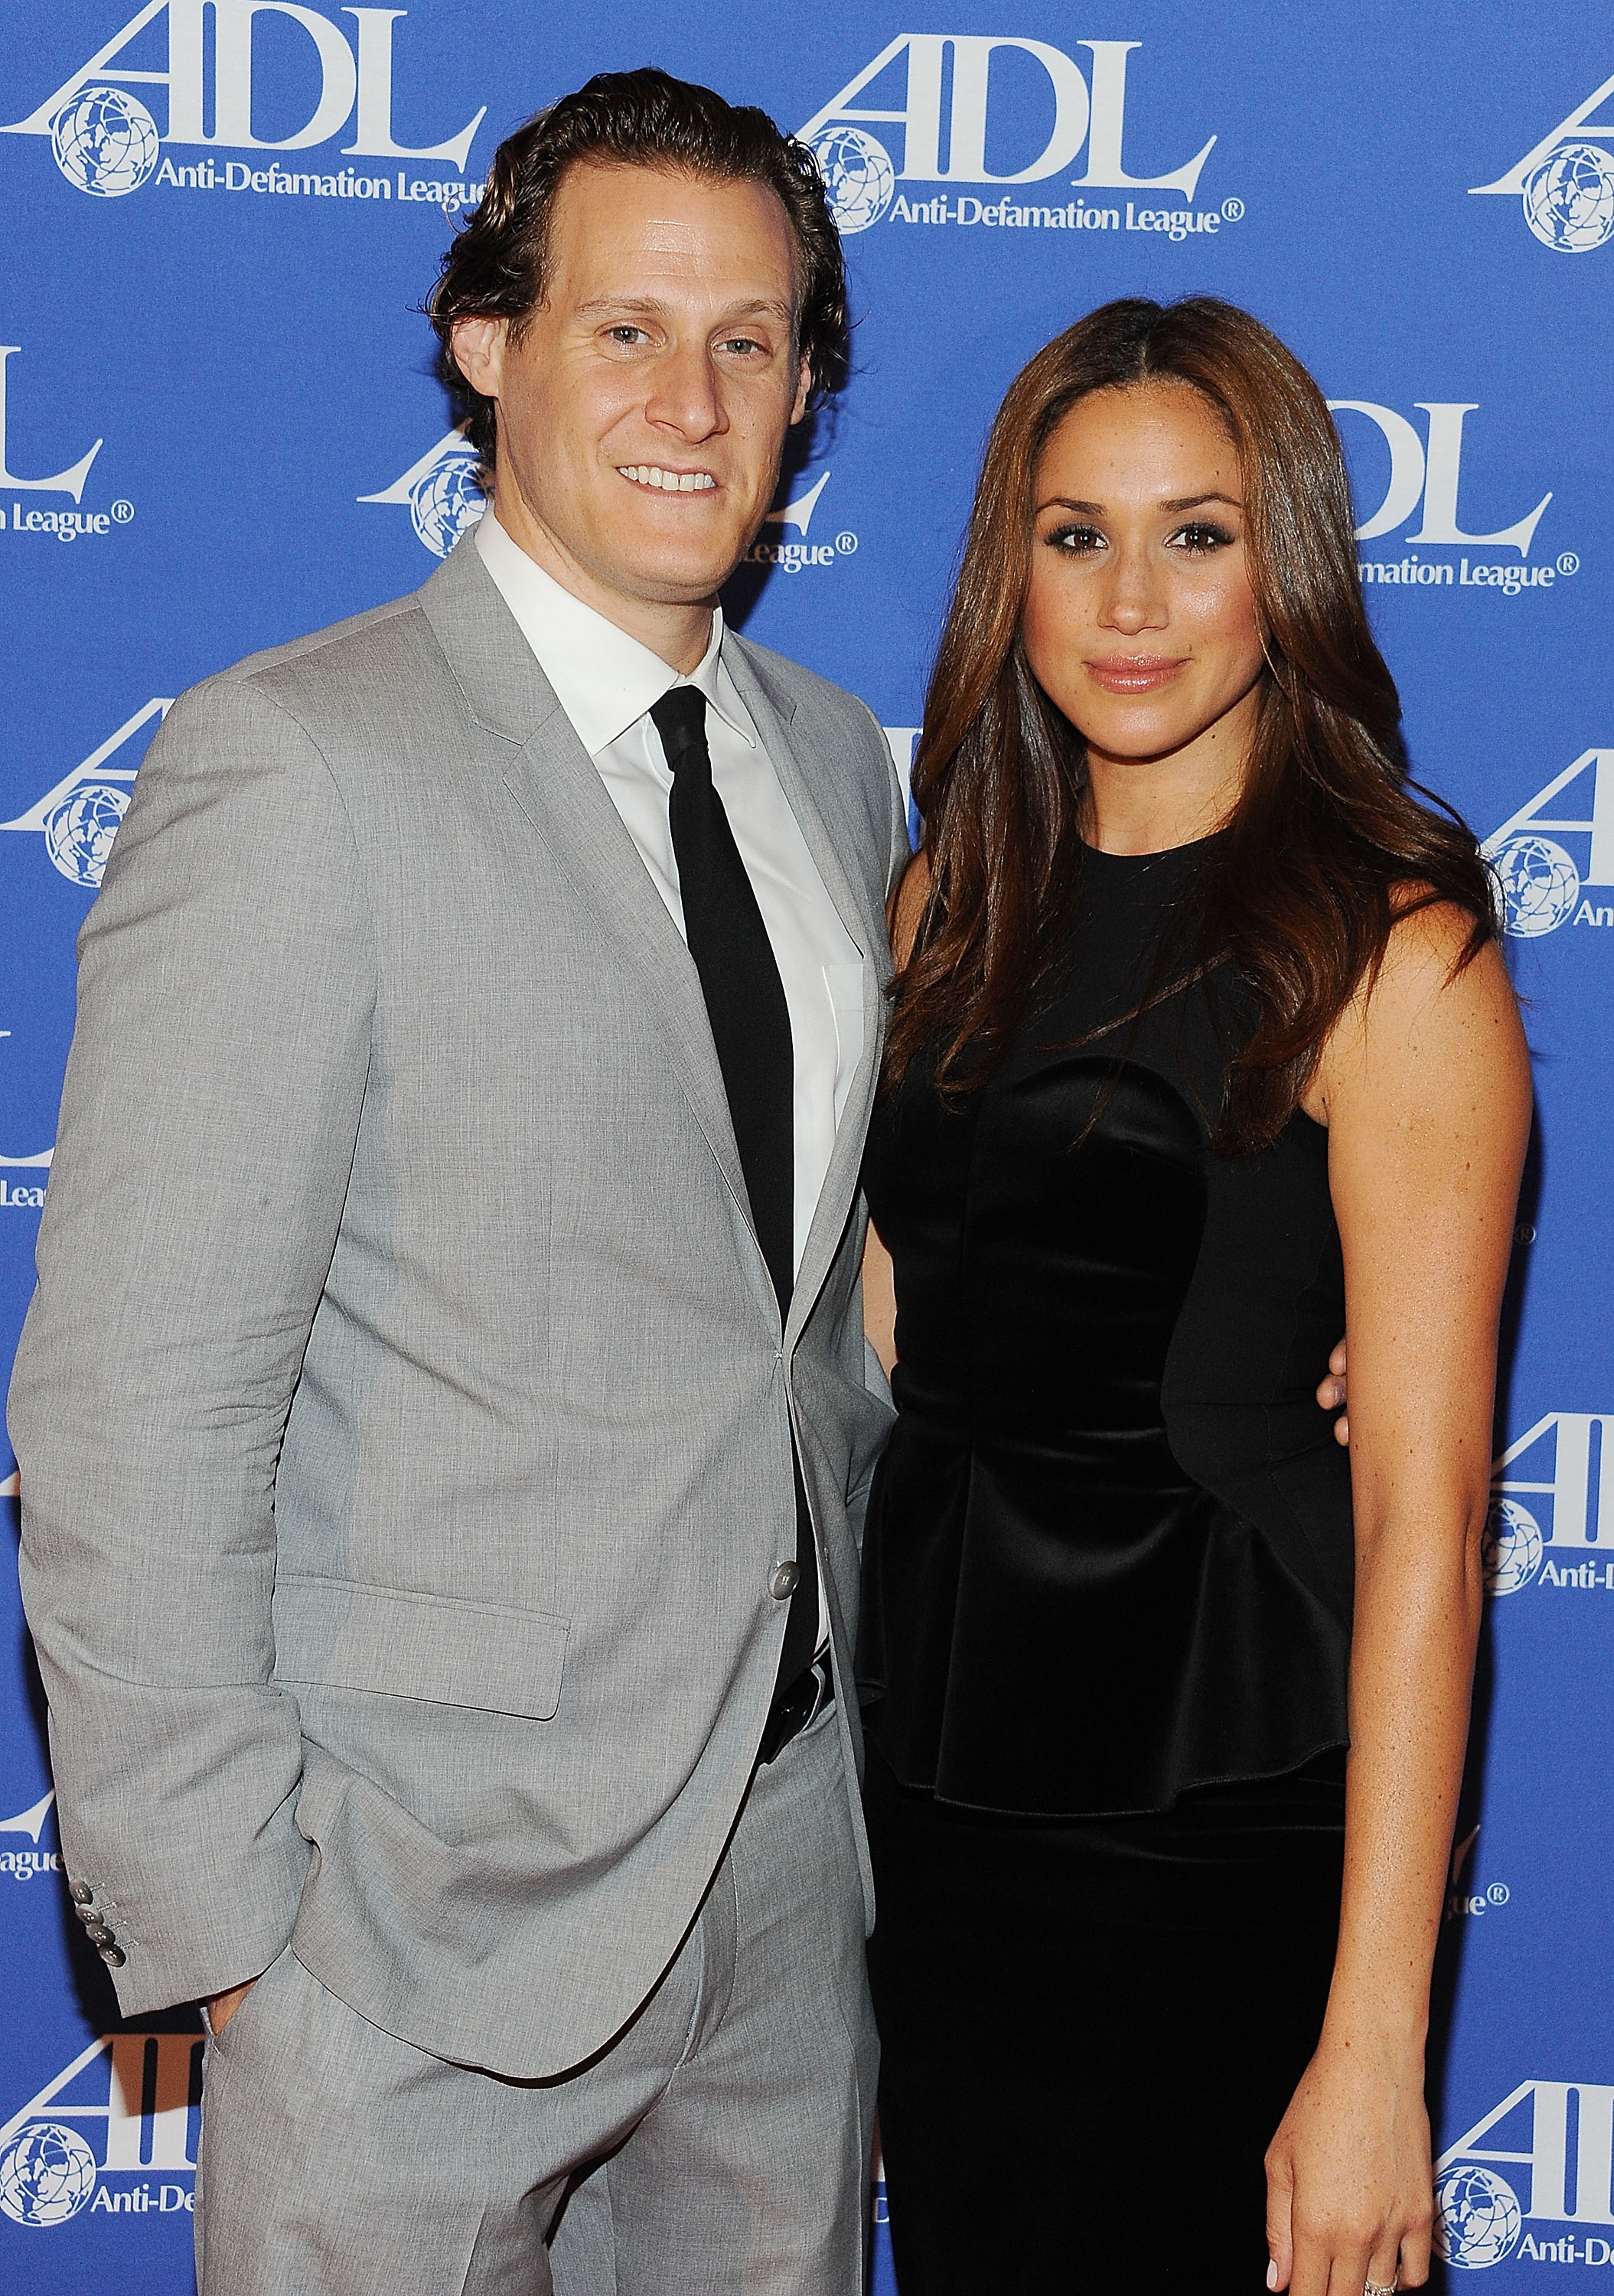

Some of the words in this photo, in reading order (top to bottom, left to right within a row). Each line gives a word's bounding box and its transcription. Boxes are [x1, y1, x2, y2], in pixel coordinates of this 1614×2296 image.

[0, 0, 487, 174] ADL
[794, 33, 1218, 203] ADL
[155, 158, 391, 200] Anti-Defamation
[889, 194, 1120, 230] Anti-Defamation
[0, 1179, 47, 1208] Lea
[1516, 2232, 1614, 2266] Anti-D
